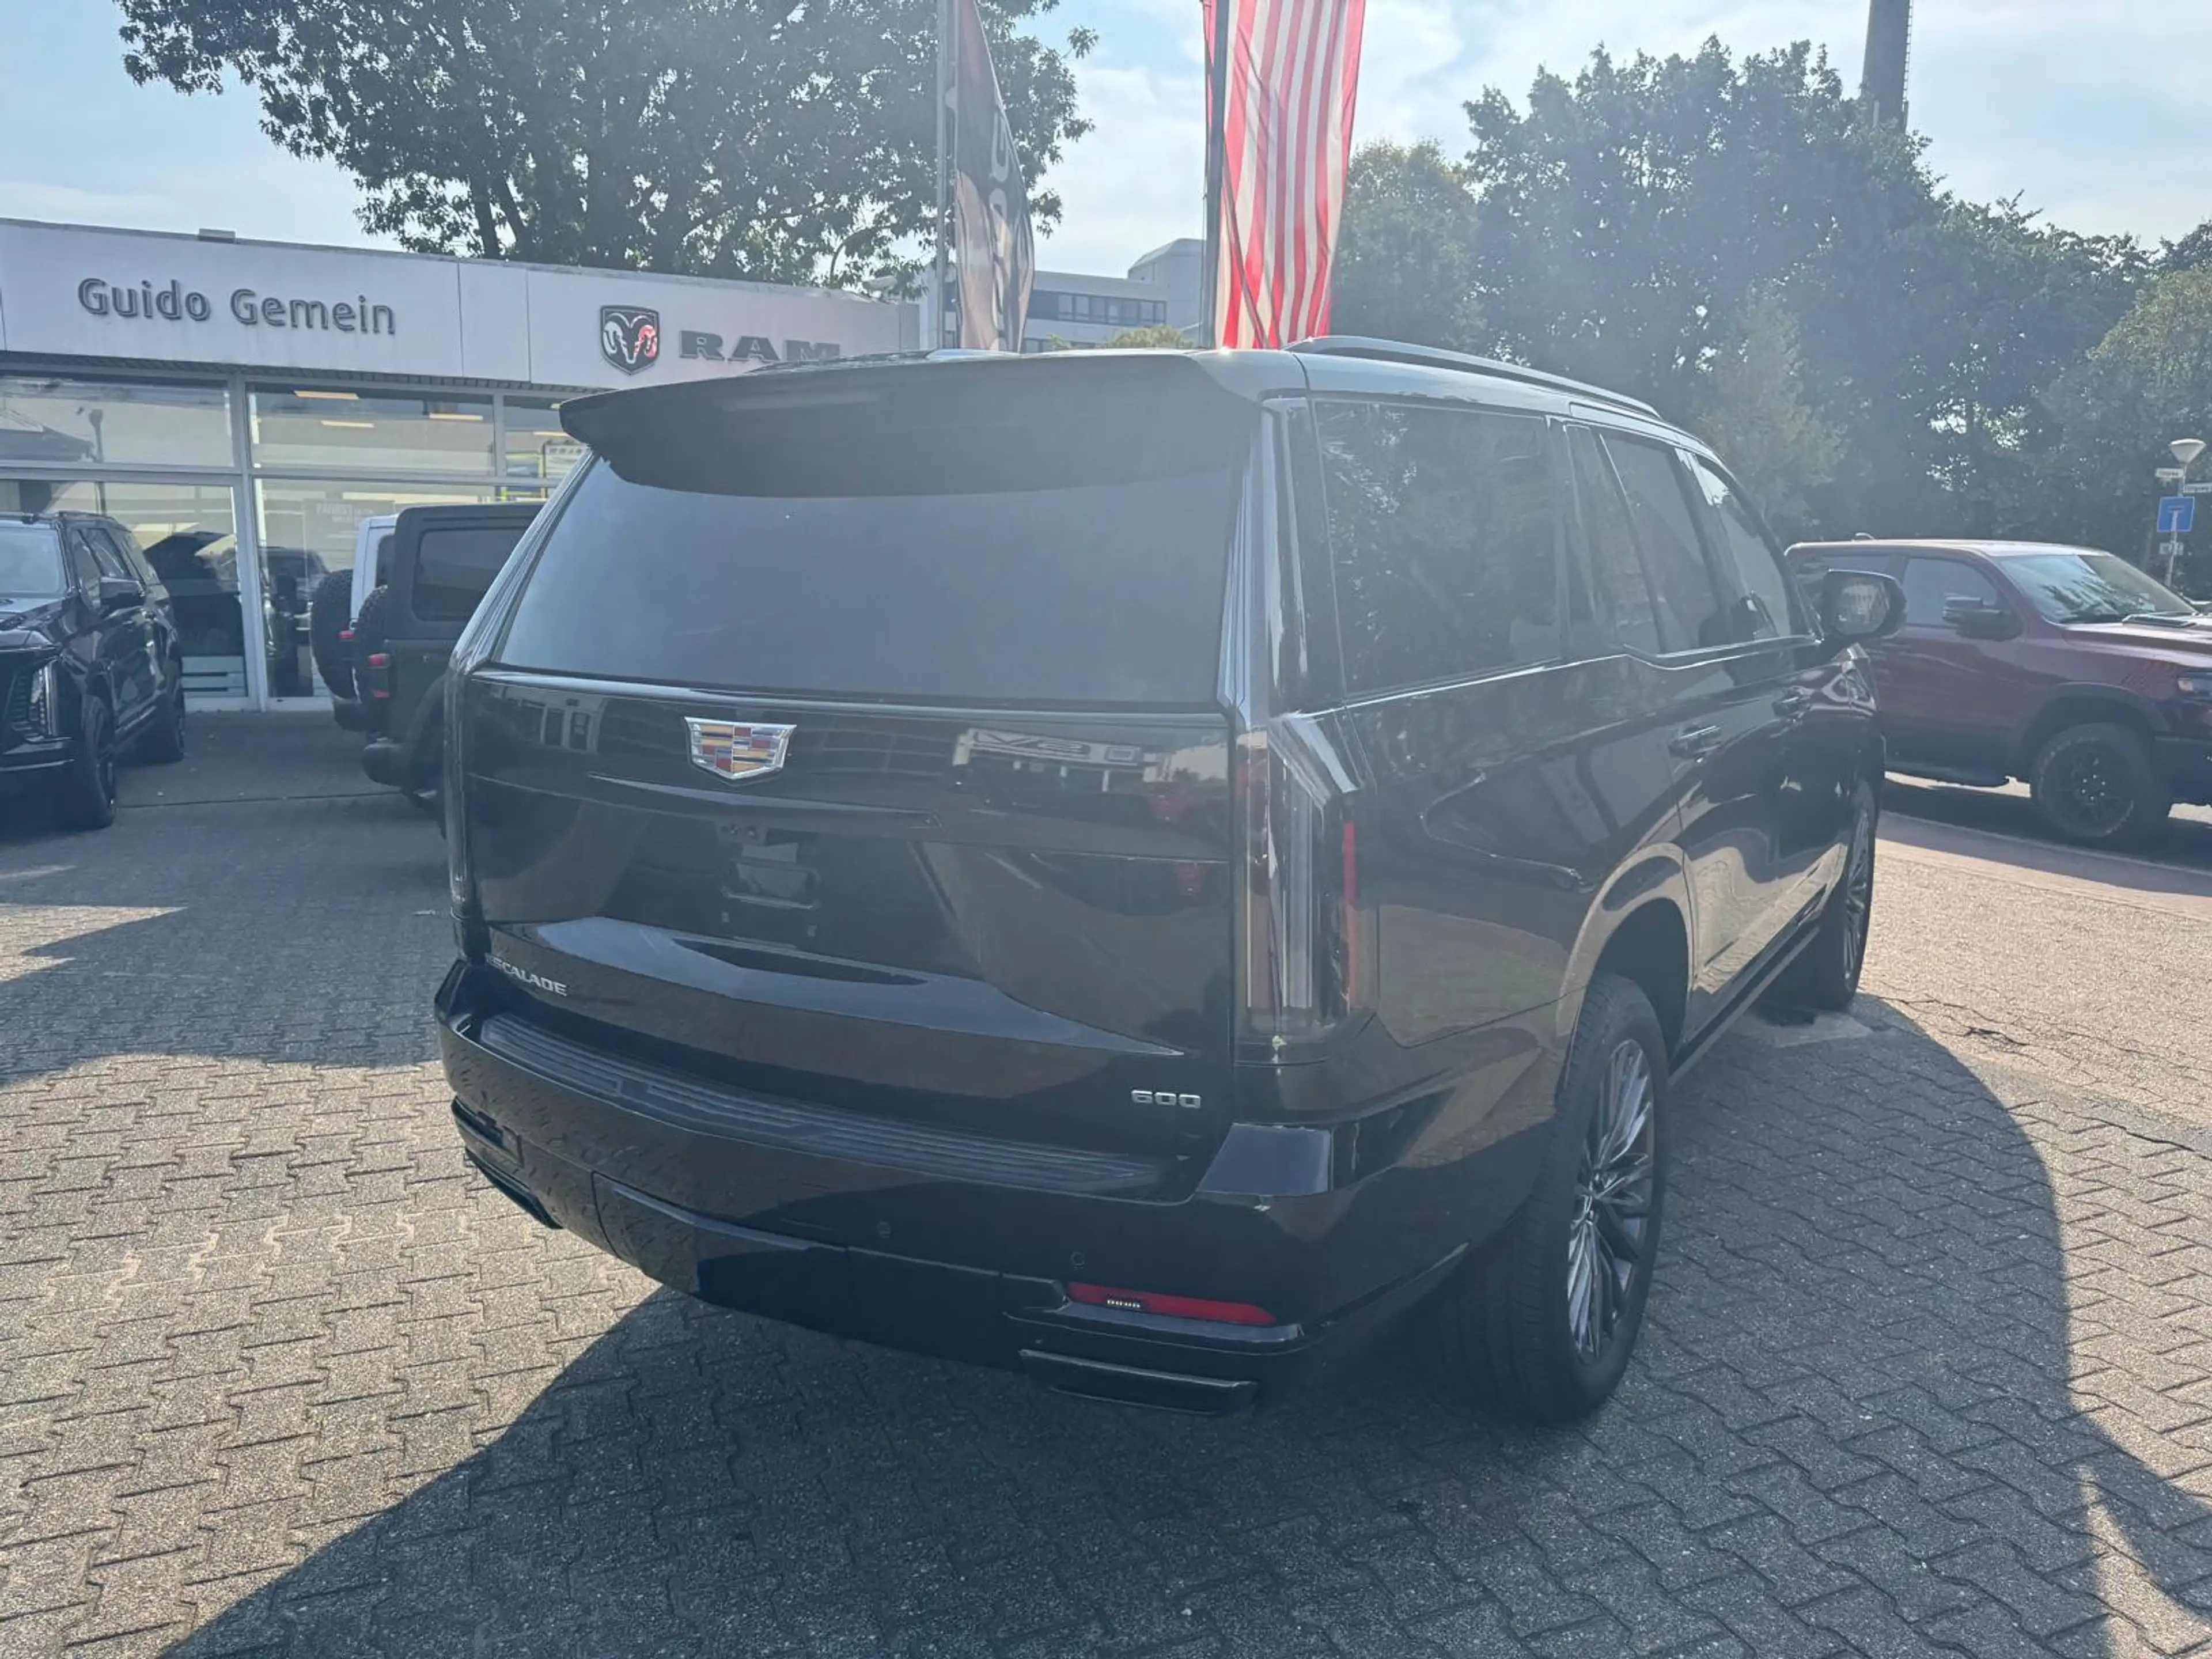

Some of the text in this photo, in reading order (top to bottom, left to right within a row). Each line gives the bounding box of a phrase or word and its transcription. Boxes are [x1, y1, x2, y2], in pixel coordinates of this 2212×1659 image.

[78, 278, 396, 335] Guido Gemein
[679, 330, 840, 362] RAM
[1131, 1090, 1201, 1109] 600
